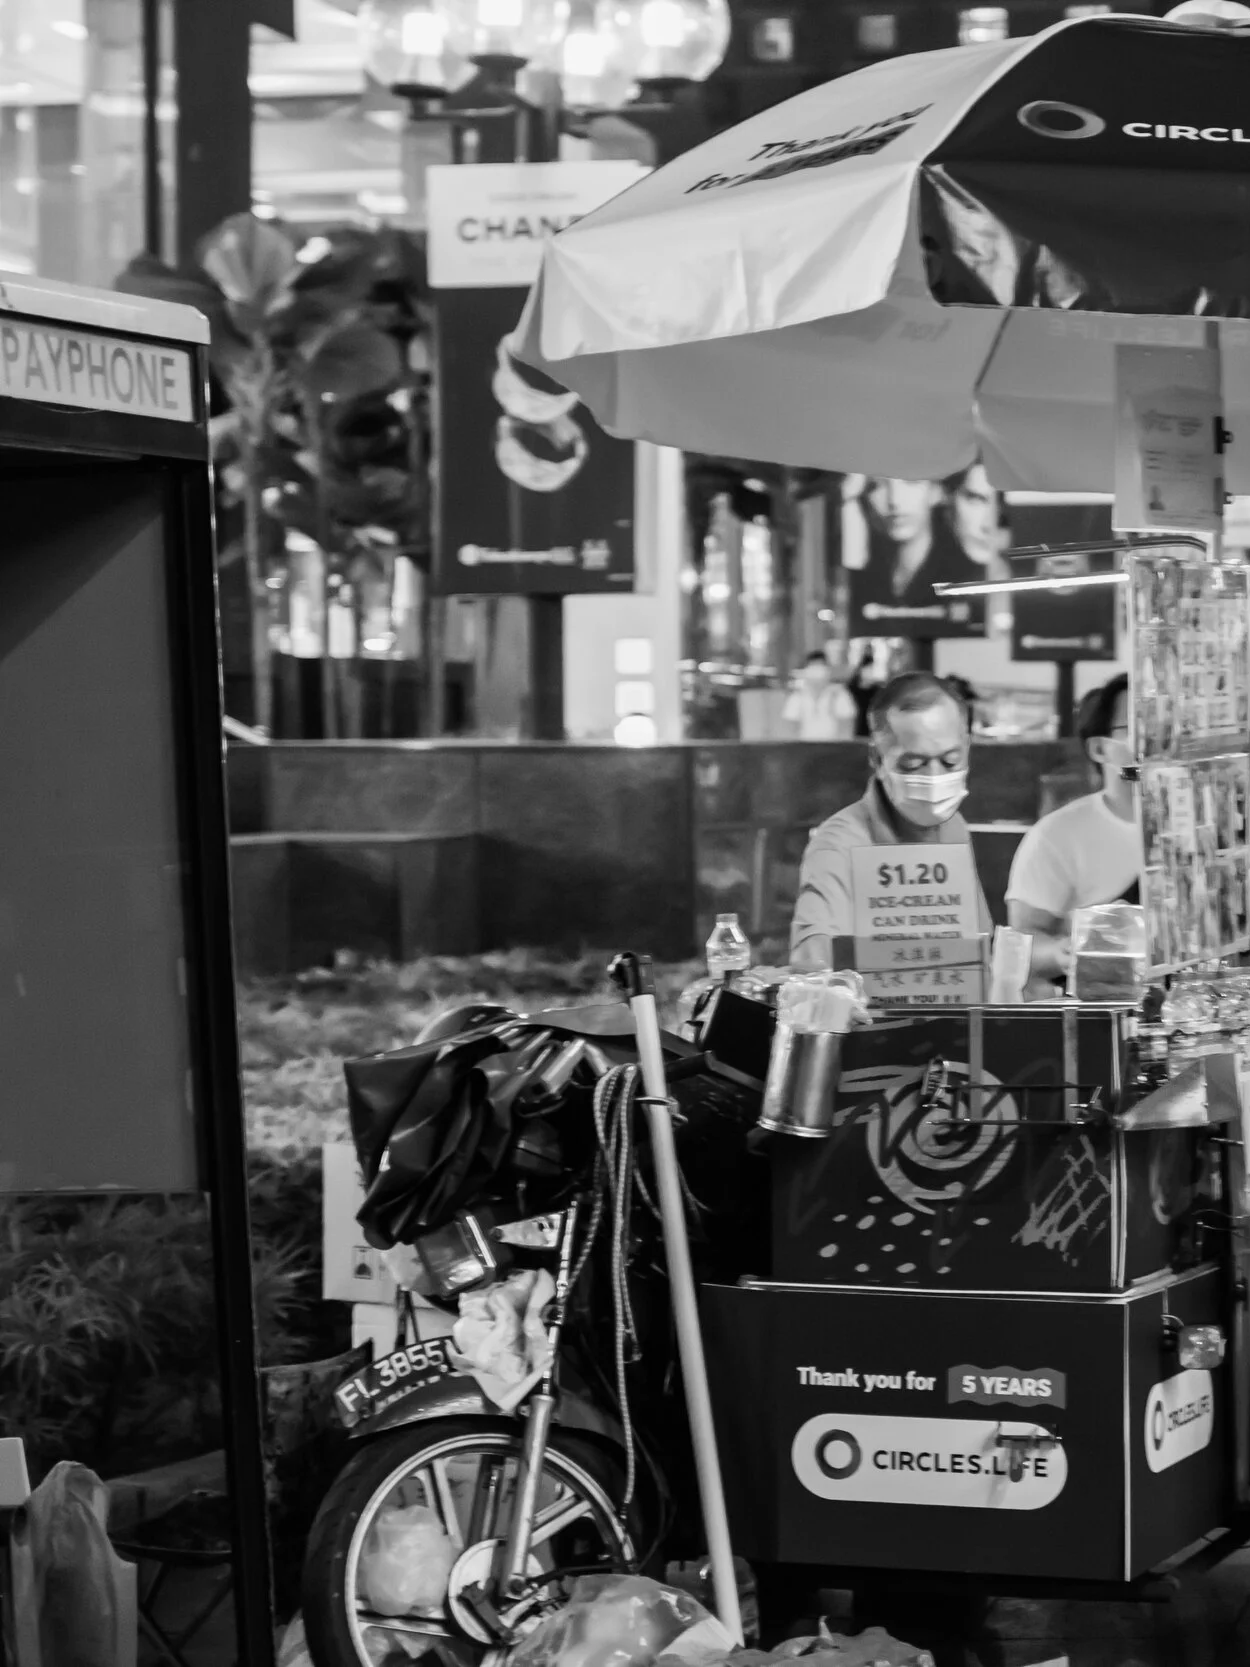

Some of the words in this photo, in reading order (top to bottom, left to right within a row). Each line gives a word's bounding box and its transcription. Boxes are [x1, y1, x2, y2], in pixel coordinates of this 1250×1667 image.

[456, 213, 586, 243] CHAN
[2, 326, 178, 411] PAYPHONE
[877, 862, 948, 888] $1.20
[868, 893, 961, 909] ICE-CREAM
[872, 915, 906, 928] CAN
[796, 1366, 860, 1388] Thank
[863, 1373, 901, 1393] you
[906, 1370, 937, 1391] for
[962, 1375, 976, 1394] 5
[981, 1375, 1053, 1398] YEARS
